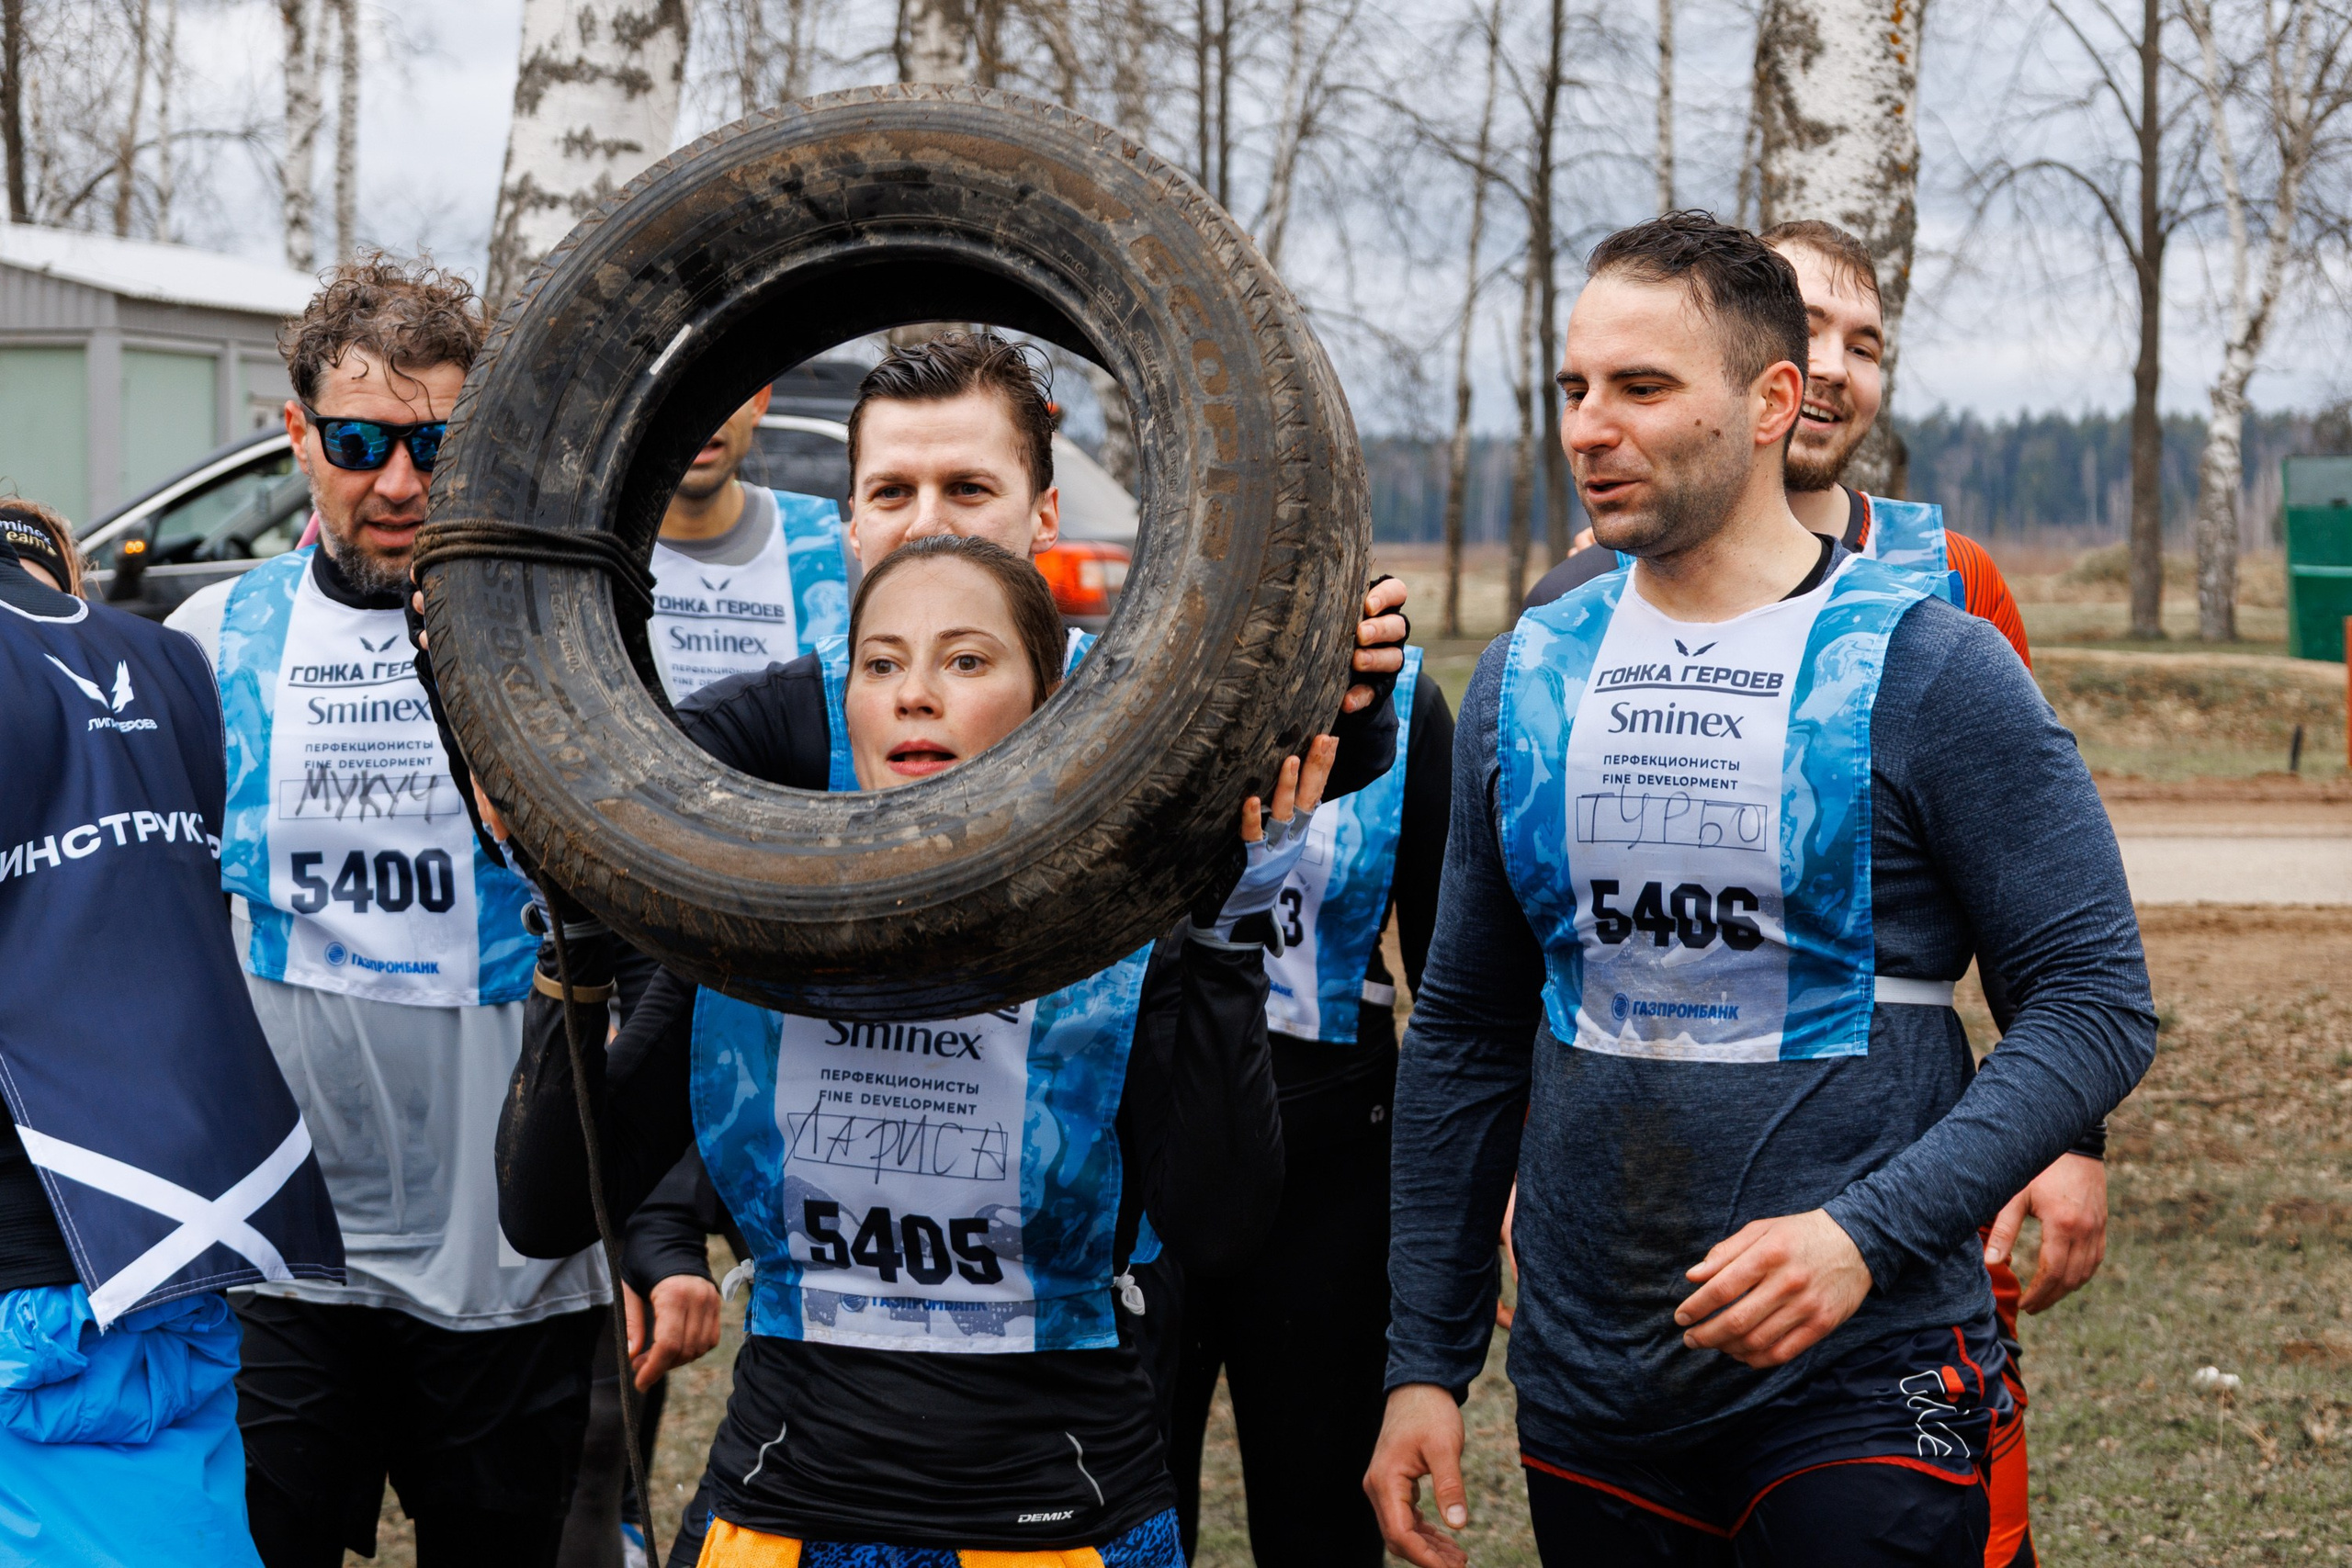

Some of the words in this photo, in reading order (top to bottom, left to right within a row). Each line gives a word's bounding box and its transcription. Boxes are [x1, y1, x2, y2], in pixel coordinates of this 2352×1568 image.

[654, 595, 710, 614] ОНКА
[716, 599, 786, 618] ГЕРОЕВ
[670, 626, 768, 655] Sminex
[290, 663, 364, 682] ГОНКА
[1597, 664, 1672, 686] ГОНКА
[1681, 666, 1784, 689] ГЕРОЕВ
[308, 694, 432, 725] Sminex
[1608, 702, 1745, 739] Sminex
[305, 740, 433, 752] ПЕРФЕКЦИОНИСТЫ
[305, 760, 332, 769] FINE
[339, 757, 433, 769] DEVELOPMENT
[1603, 755, 1740, 771] ПЕРФЕКЦИОНИСТЫ
[1602, 774, 1632, 784] FINE
[1638, 774, 1738, 790] DEVELOPMENT
[290, 848, 456, 914] 5400
[1590, 879, 1765, 952] 5406
[352, 953, 440, 975] ГАЗПРОМБАНК
[1632, 999, 1739, 1021] ГАЗПРОМБАНК
[825, 1020, 983, 1060] Sminex
[820, 1068, 979, 1095] ПЕРФЕКЦИОНИСТЫ
[820, 1089, 853, 1102] FINE
[861, 1093, 978, 1115] DEVELOPMENT
[783, 1101, 1007, 1185] ЛАРИСА
[804, 1200, 1003, 1285] 5405
[1018, 1510, 1074, 1523] DEMIX
